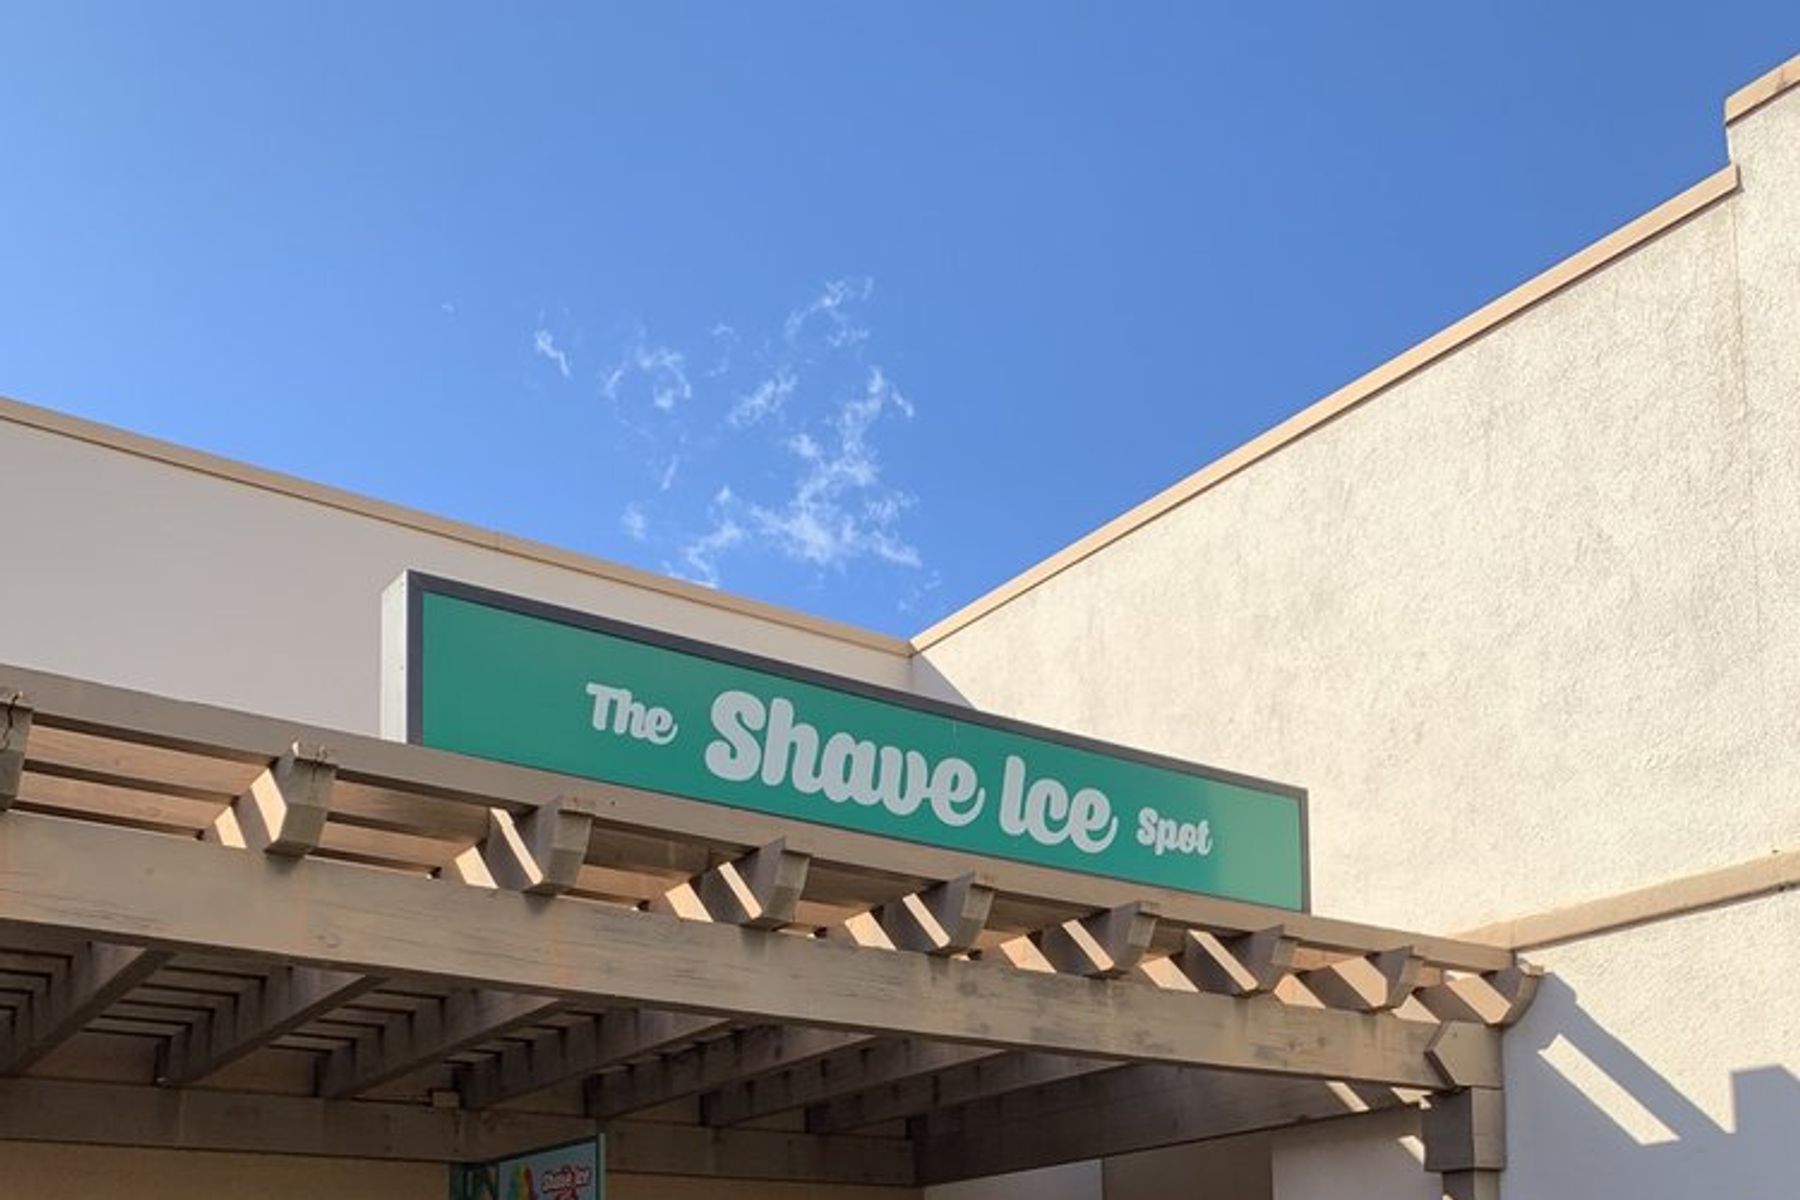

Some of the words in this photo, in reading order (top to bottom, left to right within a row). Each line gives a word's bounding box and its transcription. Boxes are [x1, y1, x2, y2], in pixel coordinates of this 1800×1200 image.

[586, 681, 678, 745] The
[705, 690, 986, 827] Shave
[999, 755, 1118, 854] Ice
[1136, 806, 1213, 856] Spot
